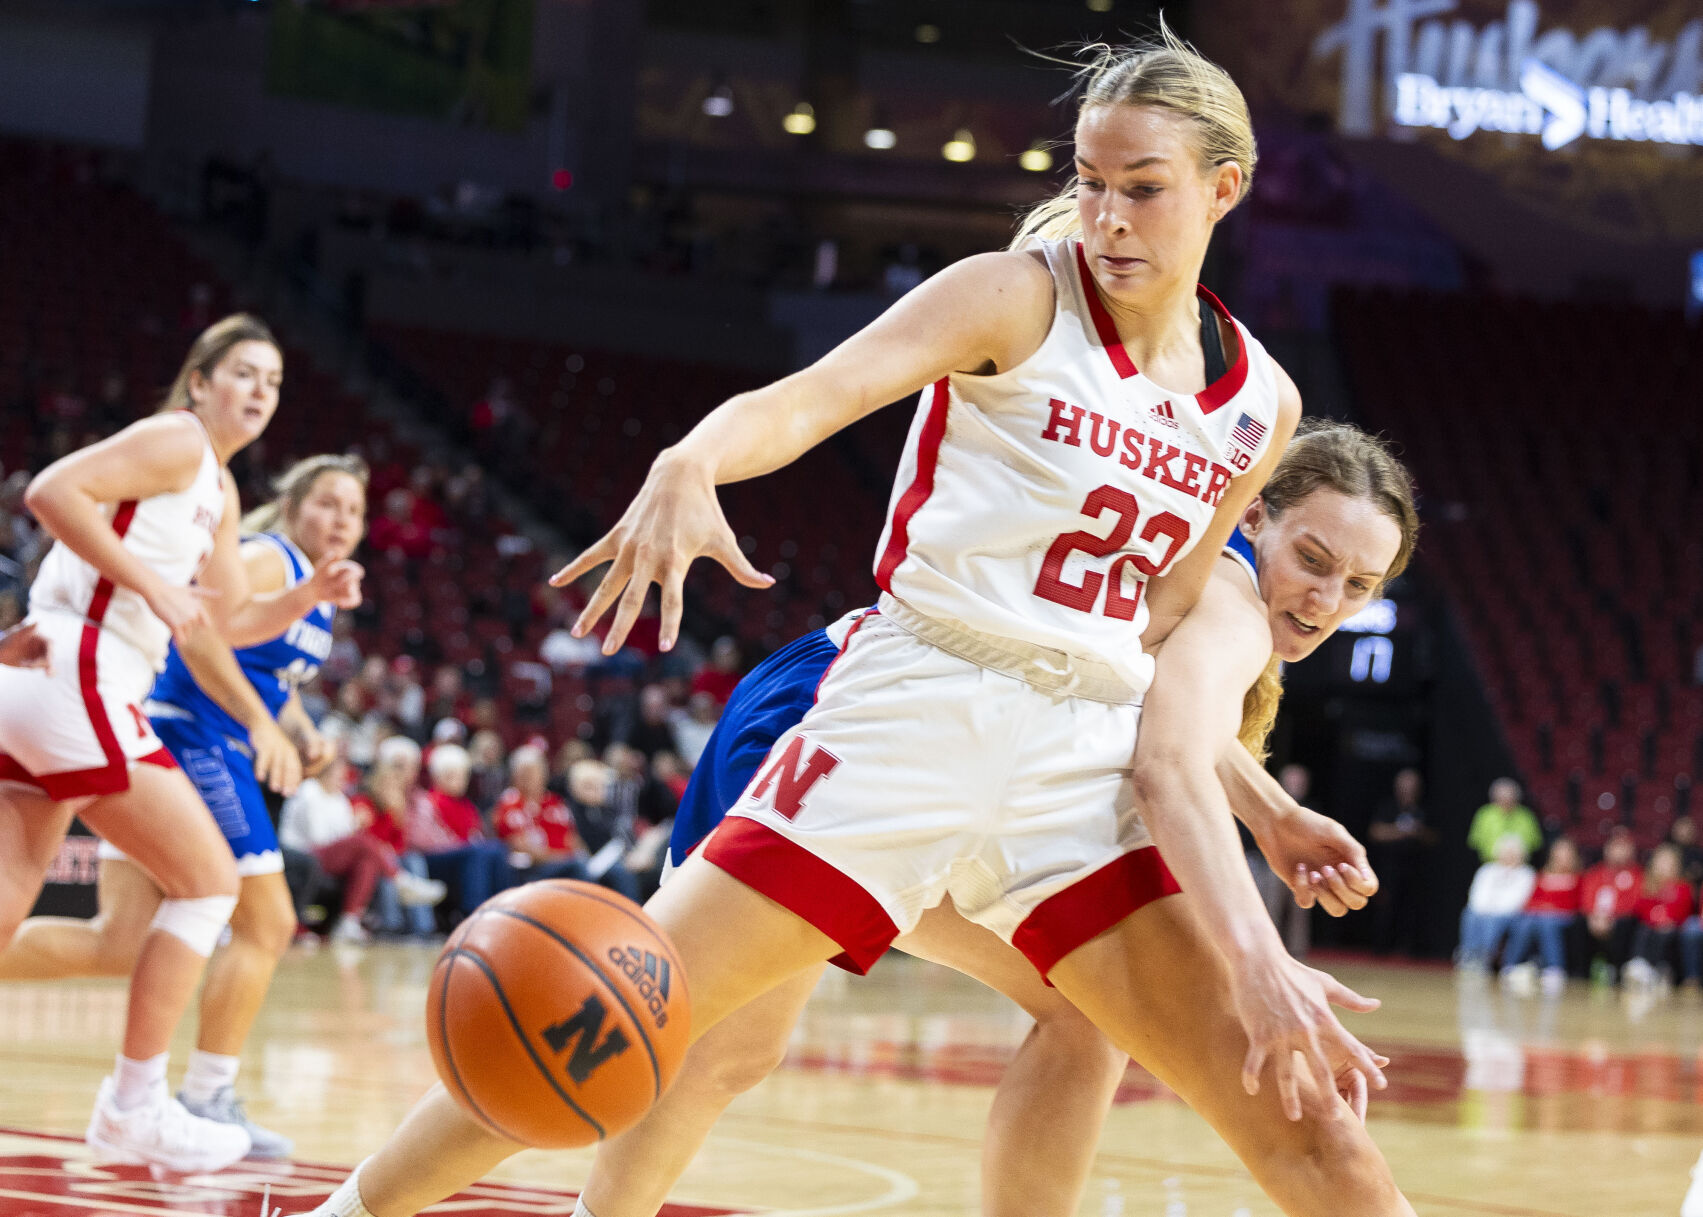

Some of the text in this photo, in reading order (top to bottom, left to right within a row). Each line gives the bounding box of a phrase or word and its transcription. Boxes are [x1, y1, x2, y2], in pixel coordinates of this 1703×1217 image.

[1033, 484, 1190, 622] 22
[750, 733, 843, 825] N
[608, 946, 668, 1029] adidas
[543, 994, 631, 1087] N
